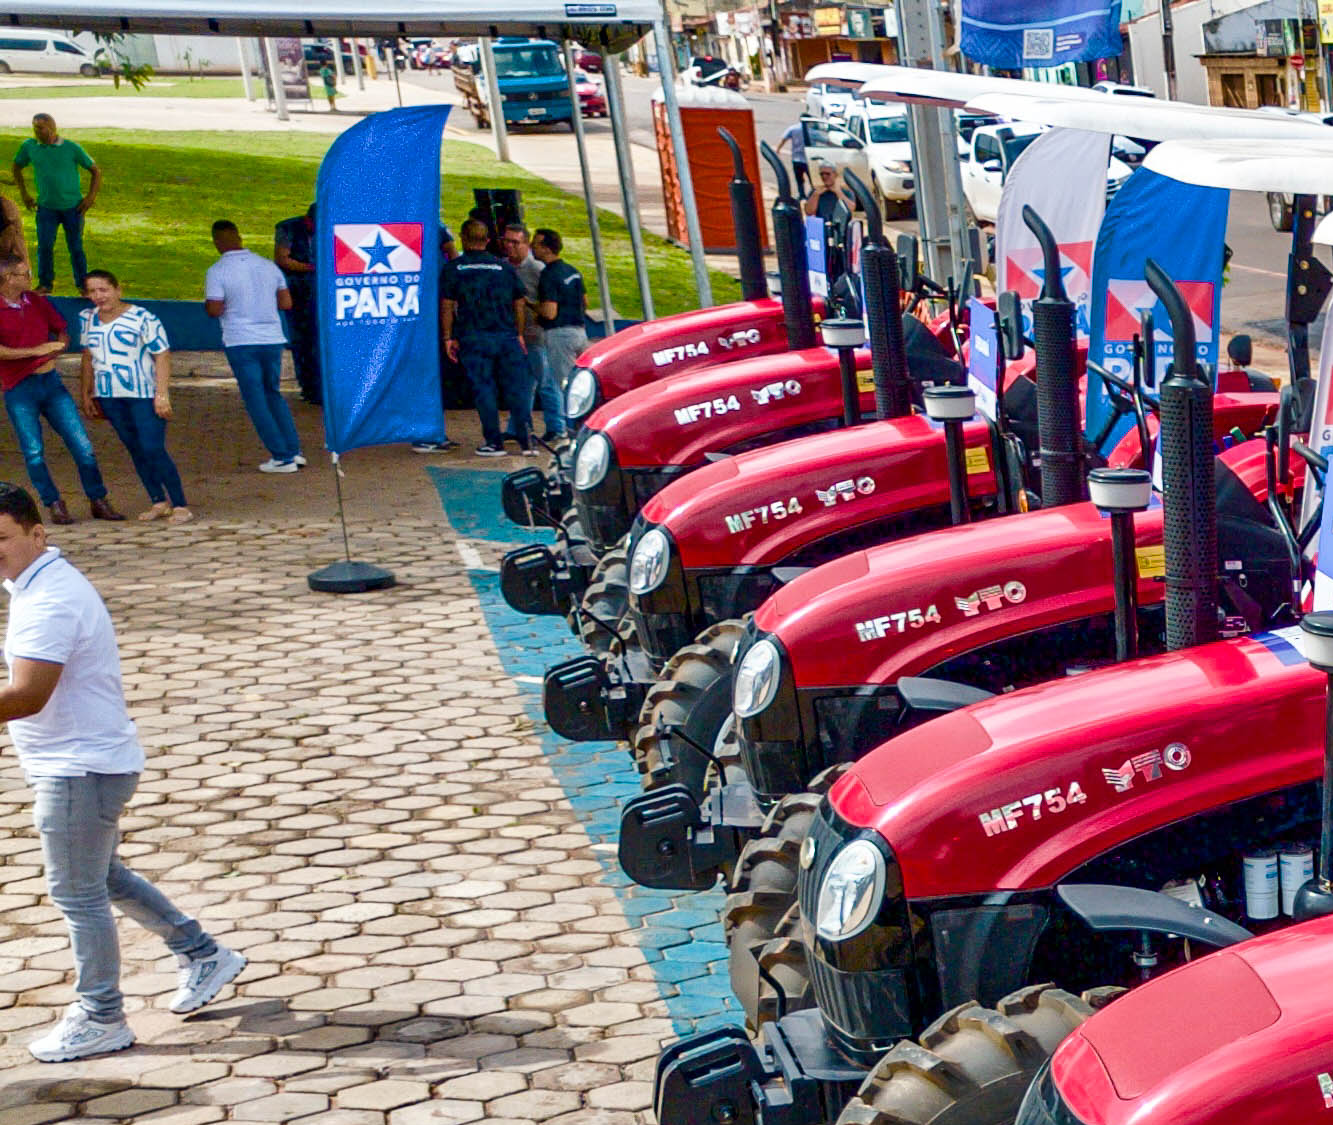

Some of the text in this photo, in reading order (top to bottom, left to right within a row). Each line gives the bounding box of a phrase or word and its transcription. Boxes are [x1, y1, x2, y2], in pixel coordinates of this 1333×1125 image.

[335, 274, 420, 287] GOVERNO DO
[652, 341, 710, 366] MF754
[751, 379, 802, 405] YTO
[674, 395, 741, 426] MF754
[815, 476, 876, 507] YTO
[725, 497, 803, 534] MF754
[954, 580, 1027, 617] YTO
[855, 604, 942, 642] MF754
[1101, 742, 1192, 793] YTO
[978, 781, 1088, 837] MF754
